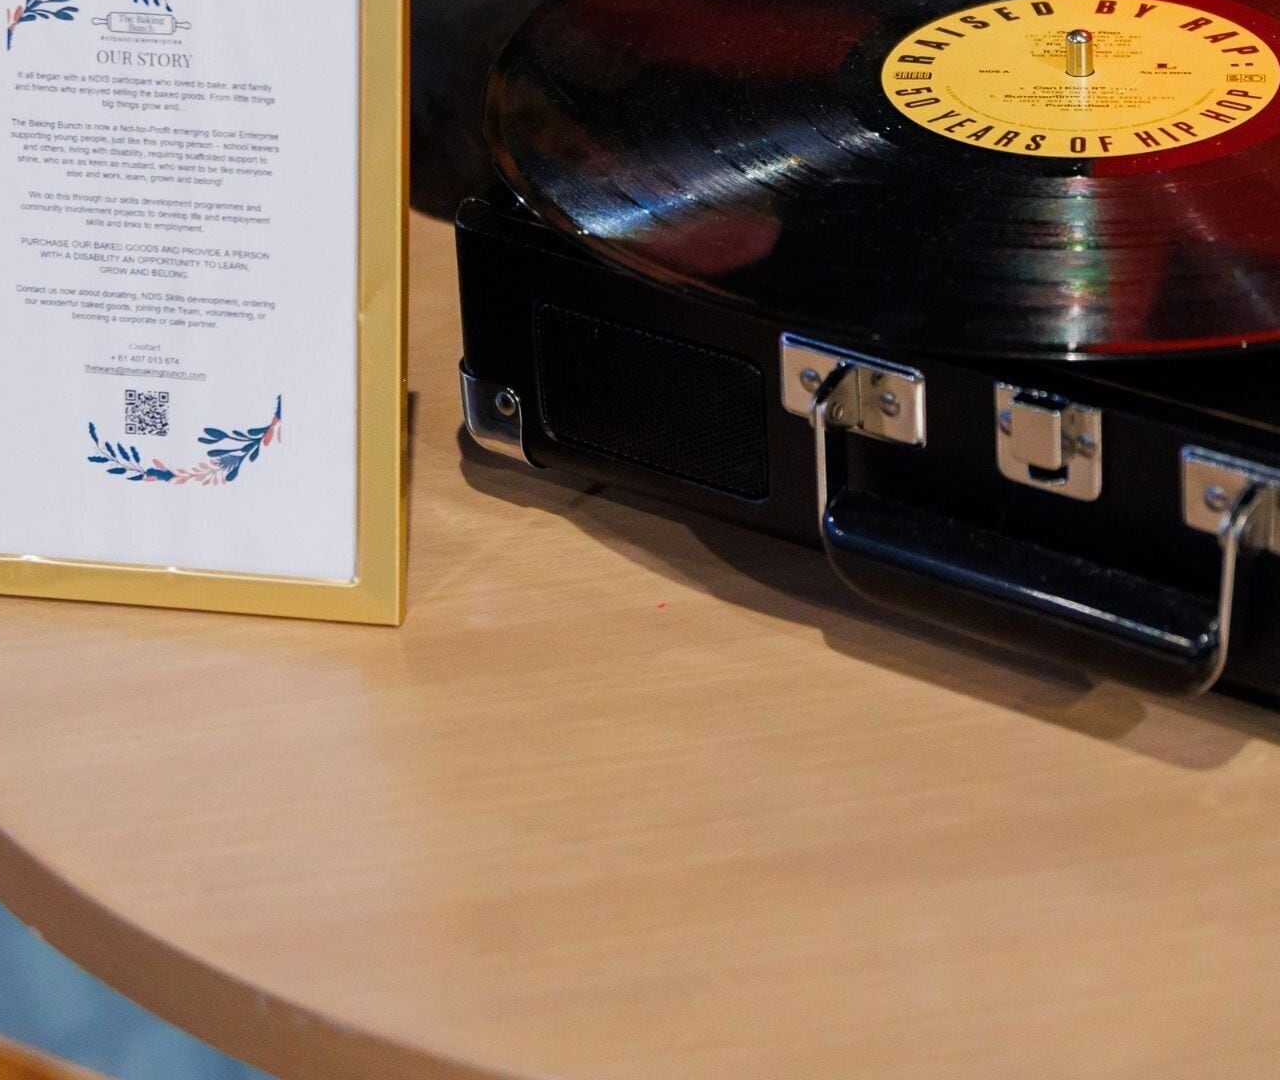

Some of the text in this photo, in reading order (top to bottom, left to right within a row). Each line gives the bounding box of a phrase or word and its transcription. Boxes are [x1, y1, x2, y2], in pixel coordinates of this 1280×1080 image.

[897, 1, 1055, 65] RAISED
[1095, 0, 1157, 18] BY
[96, 50, 192, 68] OUR STORY
[36, 71, 61, 81] began
[63, 73, 79, 81] with
[89, 74, 110, 83] NDIS
[112, 76, 153, 86] participant
[155, 78, 171, 86] who
[174, 79, 195, 88] loved
[231, 83, 246, 91] and
[248, 83, 272, 94] family
[15, 82, 29, 90] and
[31, 83, 58, 92] friends
[60, 85, 77, 93] who
[79, 86, 110, 96] enjoyed
[112, 88, 137, 98] selling
[139, 89, 152, 97] the
[154, 90, 178, 99] baked
[210, 93, 231, 102] From
[233, 94, 249, 103] little
[251, 96, 275, 106] things
[102, 99, 161, 111] big things grow
[11, 118, 26, 126] The
[29, 119, 55, 129] Baking
[58, 121, 83, 129] Bunch
[172, 128, 209, 138] emerging
[212, 129, 236, 138] Social
[239, 131, 279, 141] Enterprise
[895, 86, 941, 109] 50
[927, 109, 1046, 151] YEARS
[1070, 135, 1113, 154] OF
[1134, 121, 1198, 148] HIP
[1199, 88, 1263, 124] HOP
[10, 131, 51, 141] supporting
[53, 134, 78, 143] young
[111, 135, 126, 145] just
[128, 136, 141, 145] like
[143, 137, 157, 145] this
[159, 140, 183, 149] young
[186, 141, 213, 149] person
[222, 142, 248, 151] school
[251, 143, 280, 153] leavers
[23, 143, 37, 151] and
[69, 145, 89, 155] living
[91, 147, 107, 155] with
[148, 150, 182, 161] requiring
[227, 156, 258, 164] support
[43, 156, 59, 164] who
[89, 158, 108, 167] keen
[158, 162, 175, 170] who
[220, 166, 234, 174] like
[236, 168, 273, 177] everyone
[67, 169, 83, 177] else
[85, 170, 100, 178] and
[56, 192, 70, 200] this
[72, 193, 102, 204] through
[120, 196, 139, 204] skills
[141, 197, 192, 208] development
[194, 202, 244, 210] programmes
[20, 204, 270, 225] community involvement projects develop life and employment
[85, 218, 105, 226] skills
[124, 220, 142, 228] links
[21, 238, 270, 259] PURCHASE OUR BAKED GOODS AND PROVIDE PERSON
[40, 251, 63, 259] WITH
[73, 253, 121, 262] DISABILITY
[137, 256, 201, 267] OPPORTUNITY
[99, 266, 149, 276] GROW AND
[16, 285, 46, 294] Contact
[78, 288, 101, 297] about
[141, 292, 162, 301] NDIS
[164, 293, 185, 302] Skills
[243, 298, 275, 309] ordering
[40, 299, 78, 307] wonderful
[80, 300, 104, 309] baked
[135, 303, 161, 314] joining
[163, 305, 176, 313] the
[72, 312, 110, 323] becoming
[119, 316, 156, 324] corporate
[129, 342, 161, 351] Contact
